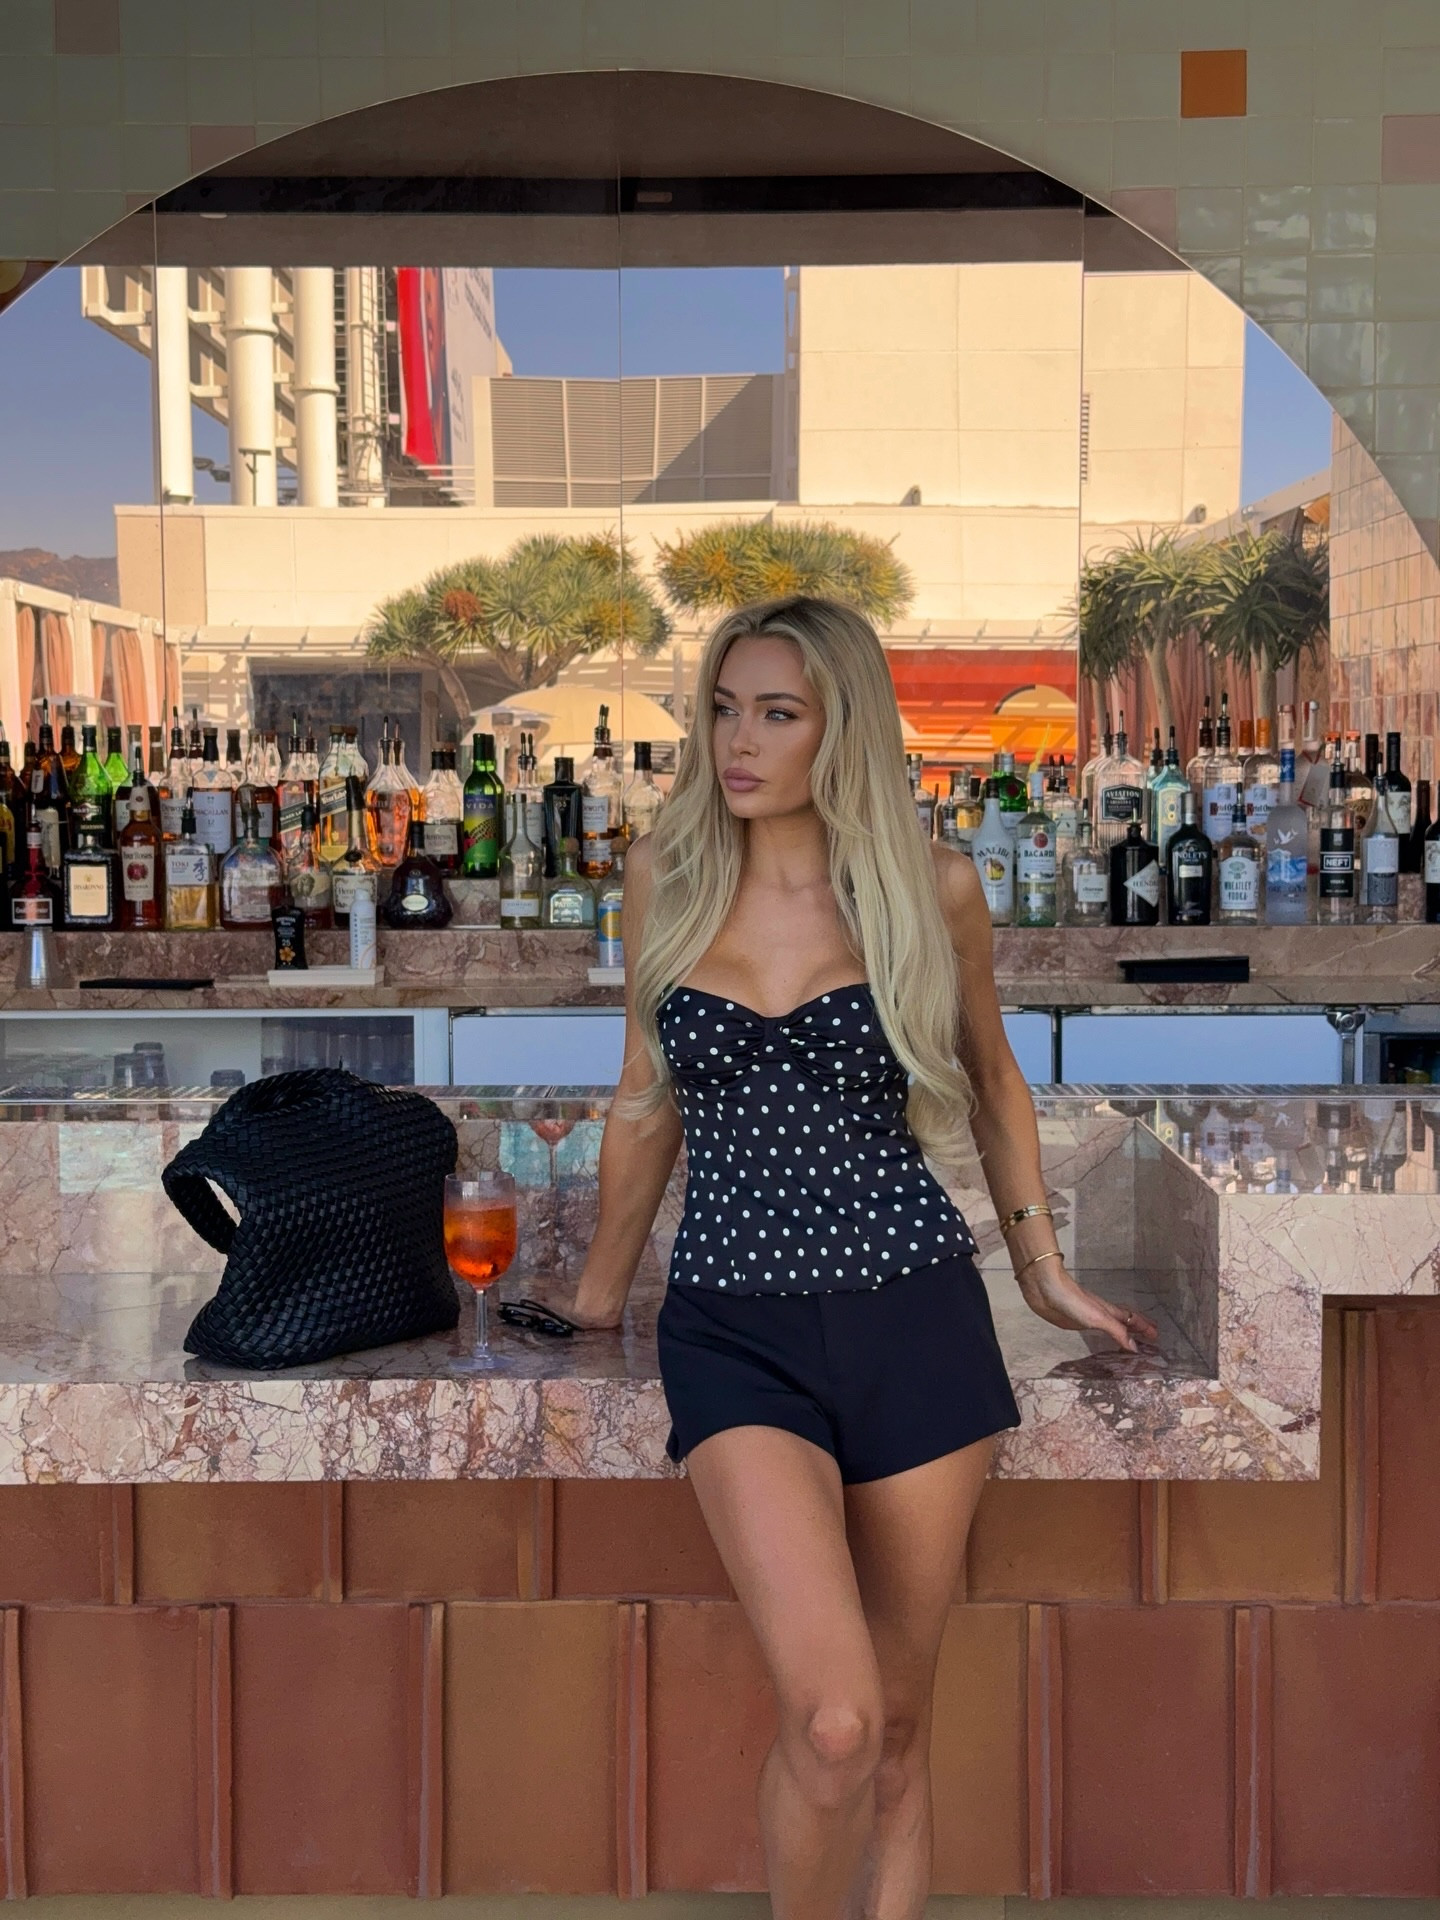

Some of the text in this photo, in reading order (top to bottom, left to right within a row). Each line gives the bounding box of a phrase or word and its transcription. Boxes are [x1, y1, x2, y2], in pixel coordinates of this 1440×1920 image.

[1106, 790, 1140, 798] AVIATION
[1325, 858, 1349, 867] NEFT
[1224, 881, 1251, 891] WHEATLEY
[1228, 891, 1247, 901] VODKA
